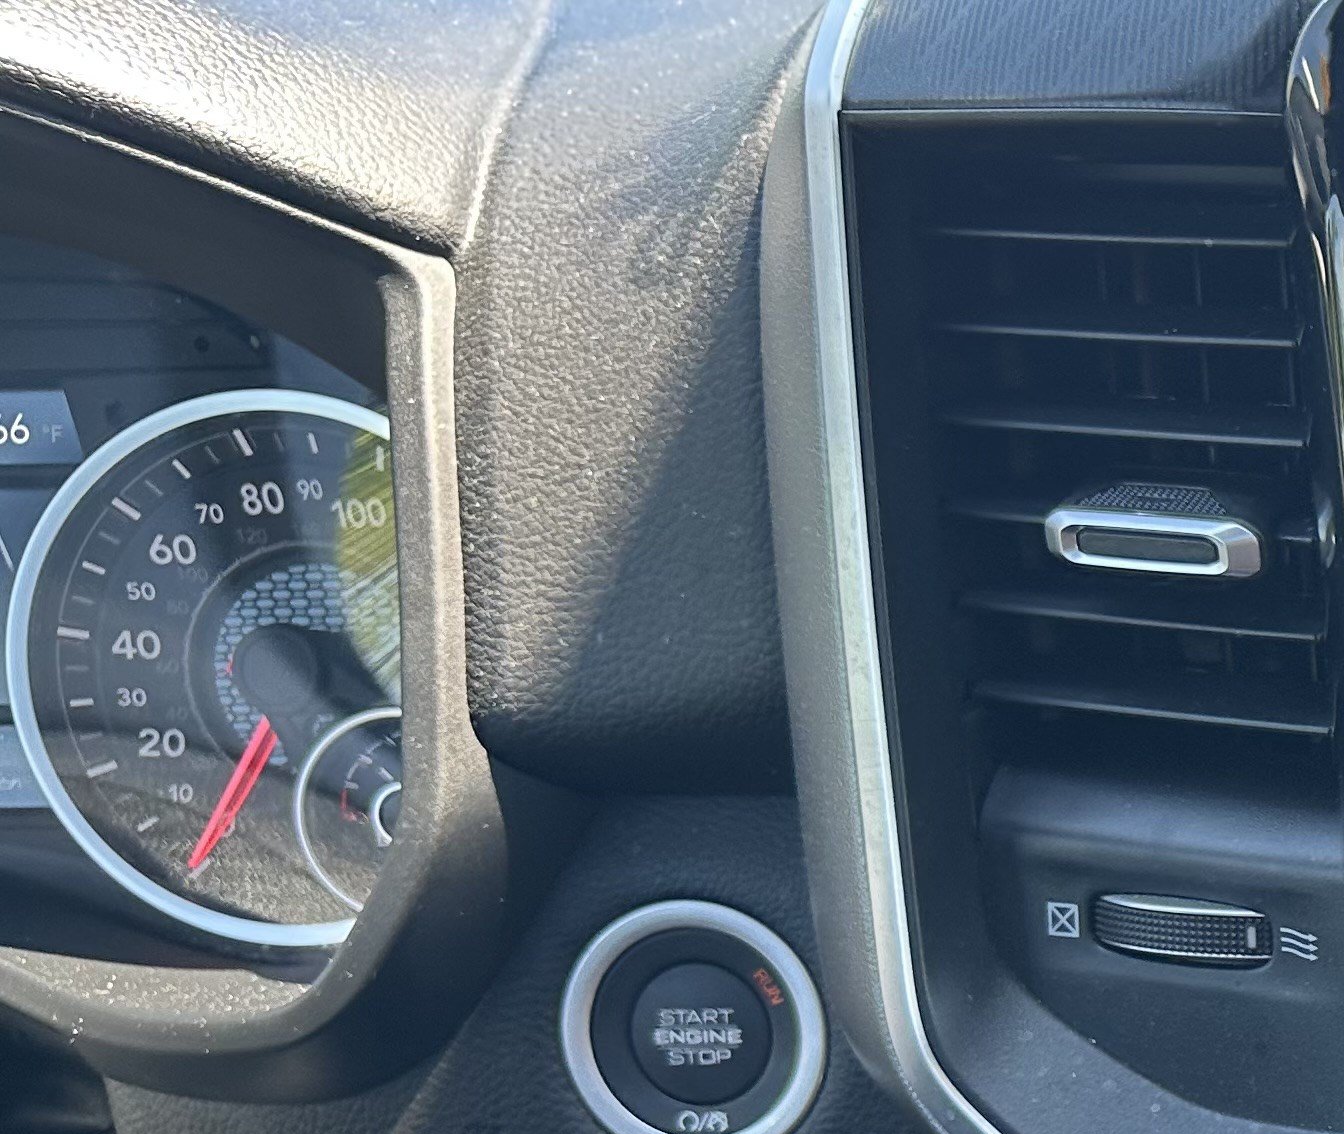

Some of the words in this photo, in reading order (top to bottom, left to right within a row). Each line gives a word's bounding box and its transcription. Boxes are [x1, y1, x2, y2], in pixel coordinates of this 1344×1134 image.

[240, 481, 285, 516] 80
[296, 479, 324, 501] 90
[195, 502, 225, 525] 70
[331, 498, 387, 530] 100
[149, 534, 197, 566] 60
[126, 581, 156, 601] 50
[112, 630, 161, 660] 40
[117, 687, 147, 708] 30
[138, 728, 186, 758] 20
[168, 783, 193, 803] 10
[753, 968, 784, 1006] RUN
[660, 1008, 734, 1026] START
[653, 1028, 743, 1046] ENGINE
[667, 1050, 731, 1066] STOP
